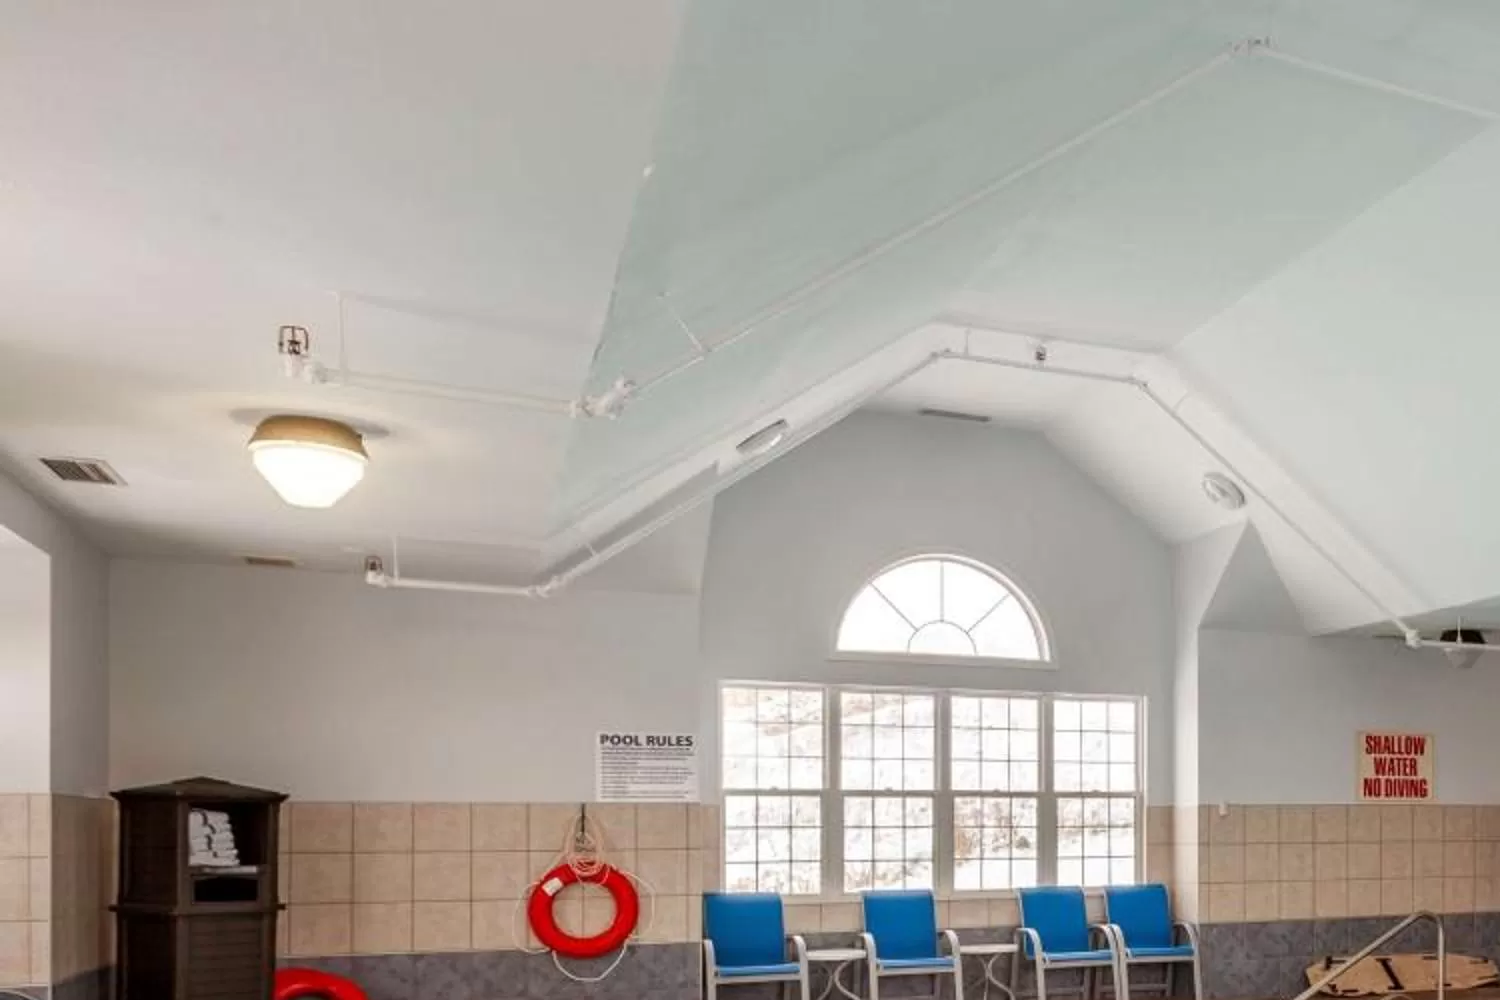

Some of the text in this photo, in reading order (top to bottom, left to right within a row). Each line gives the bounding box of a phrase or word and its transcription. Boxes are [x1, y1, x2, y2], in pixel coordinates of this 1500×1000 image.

[600, 734, 693, 747] POOL RULES
[1365, 735, 1426, 756] SHALLOW
[1374, 757, 1418, 777] WATER
[1364, 778, 1428, 798] NO DIVING
